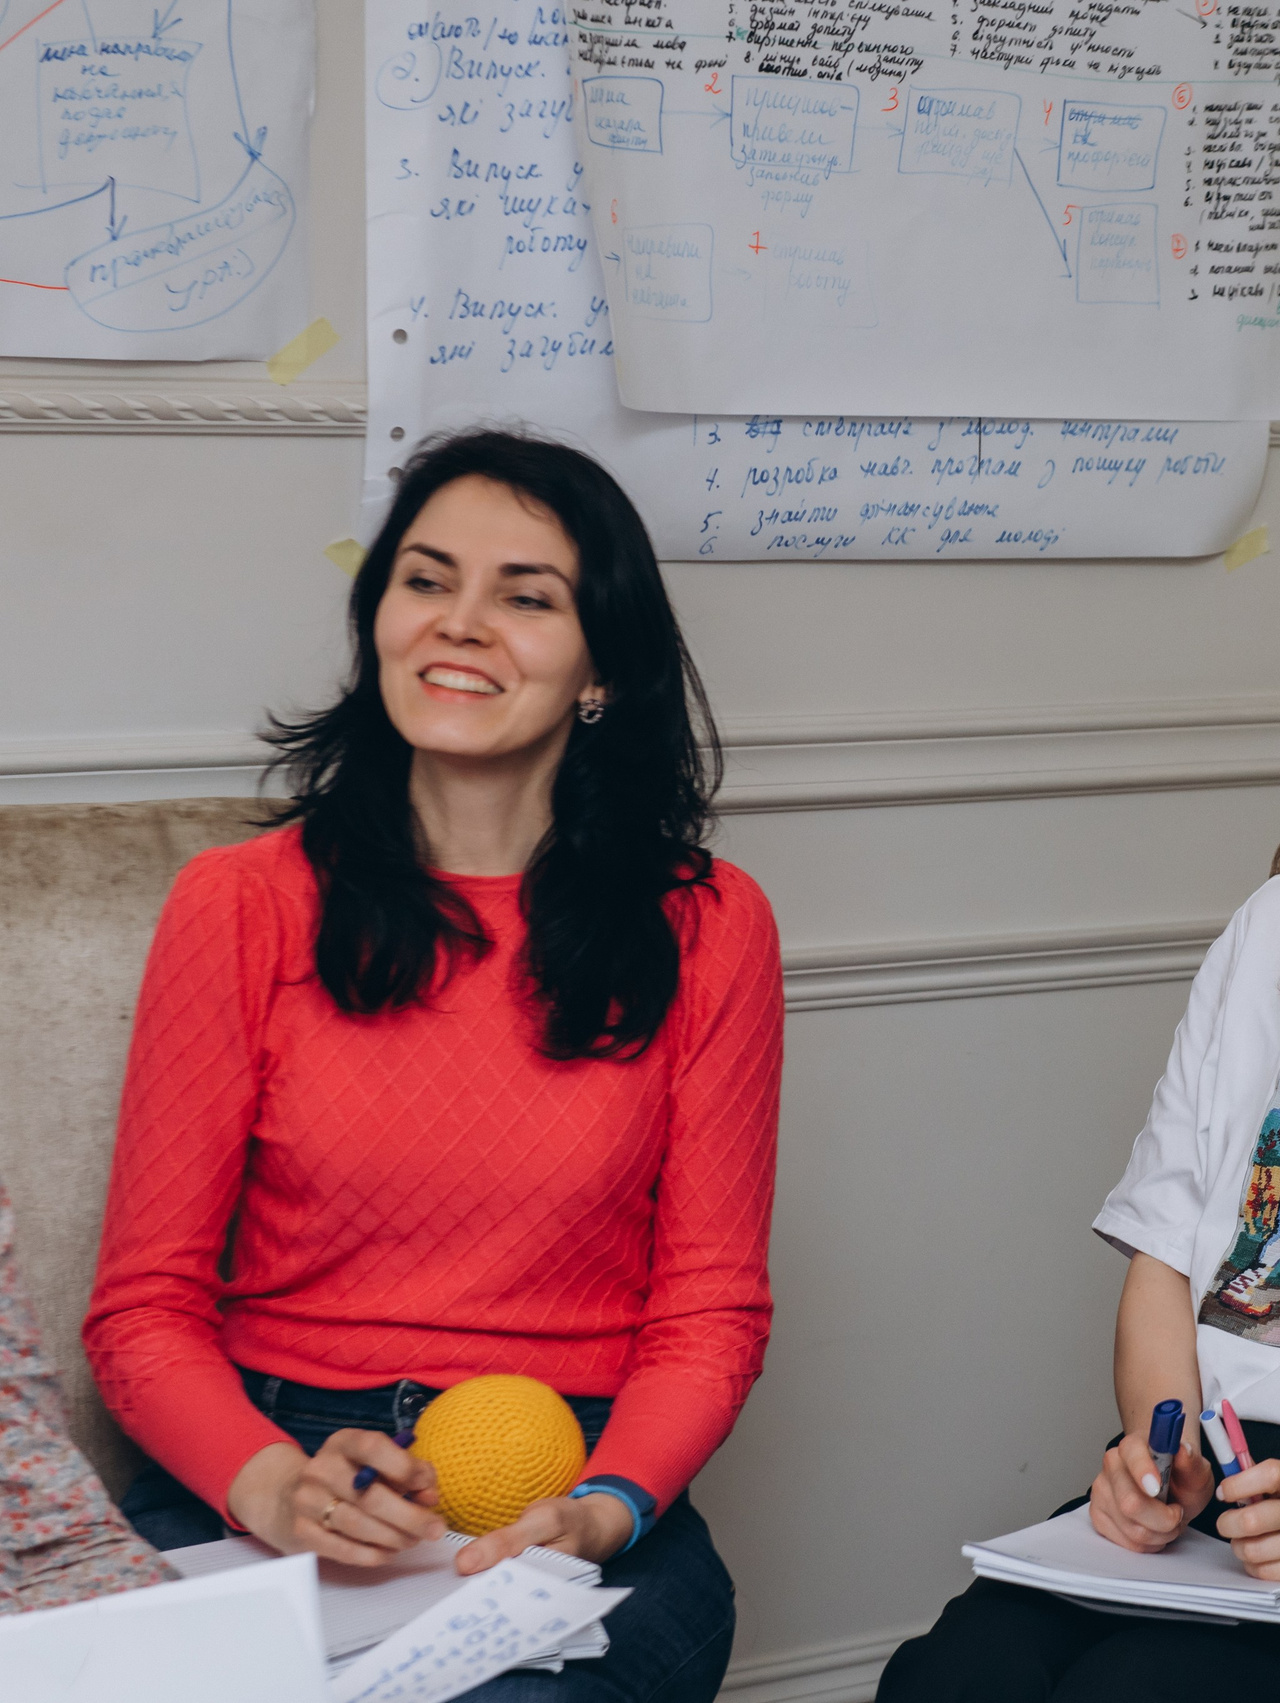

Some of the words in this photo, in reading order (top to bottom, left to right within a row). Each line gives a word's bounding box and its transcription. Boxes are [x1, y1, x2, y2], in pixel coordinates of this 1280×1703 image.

[704, 72, 723, 94] 2
[881, 87, 900, 112] 3
[1043, 99, 1053, 125] 4
[1063, 204, 1084, 226] 5
[499, 226, 589, 272] роботу
[748, 230, 770, 256] 7
[705, 467, 721, 492] 4.
[699, 510, 722, 534] 5.
